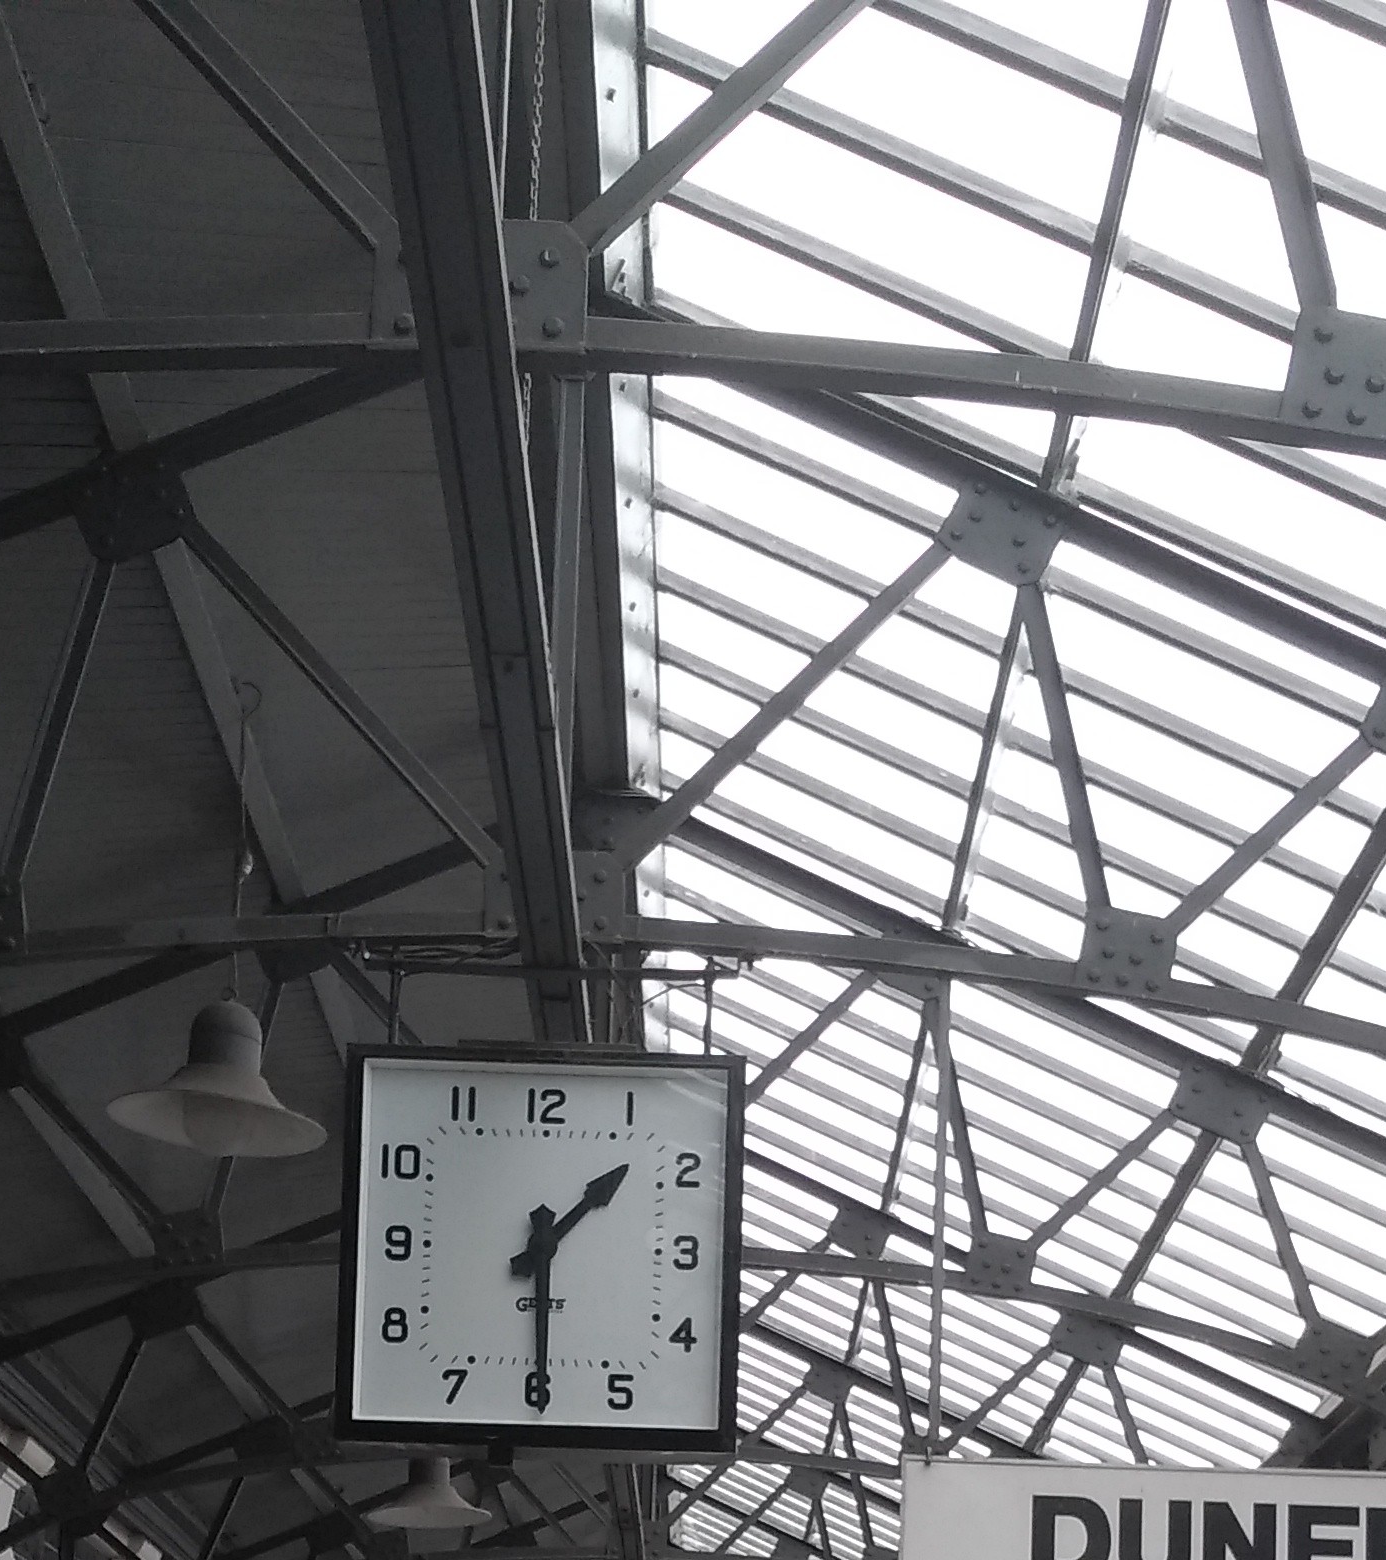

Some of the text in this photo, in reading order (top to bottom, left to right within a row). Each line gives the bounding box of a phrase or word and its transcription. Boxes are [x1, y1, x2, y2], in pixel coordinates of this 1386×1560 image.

[451, 1085, 476, 1122] 11
[527, 1088, 566, 1125] 12
[626, 1091, 634, 1126] 1
[381, 1143, 421, 1180] 10
[674, 1152, 701, 1188] 2
[385, 1225, 412, 1261] 9
[672, 1235, 699, 1271] 3
[381, 1307, 409, 1343] 8
[668, 1317, 698, 1352] 4
[442, 1369, 468, 1404] 7
[524, 1372, 551, 1408] 6
[607, 1374, 634, 1411] 5
